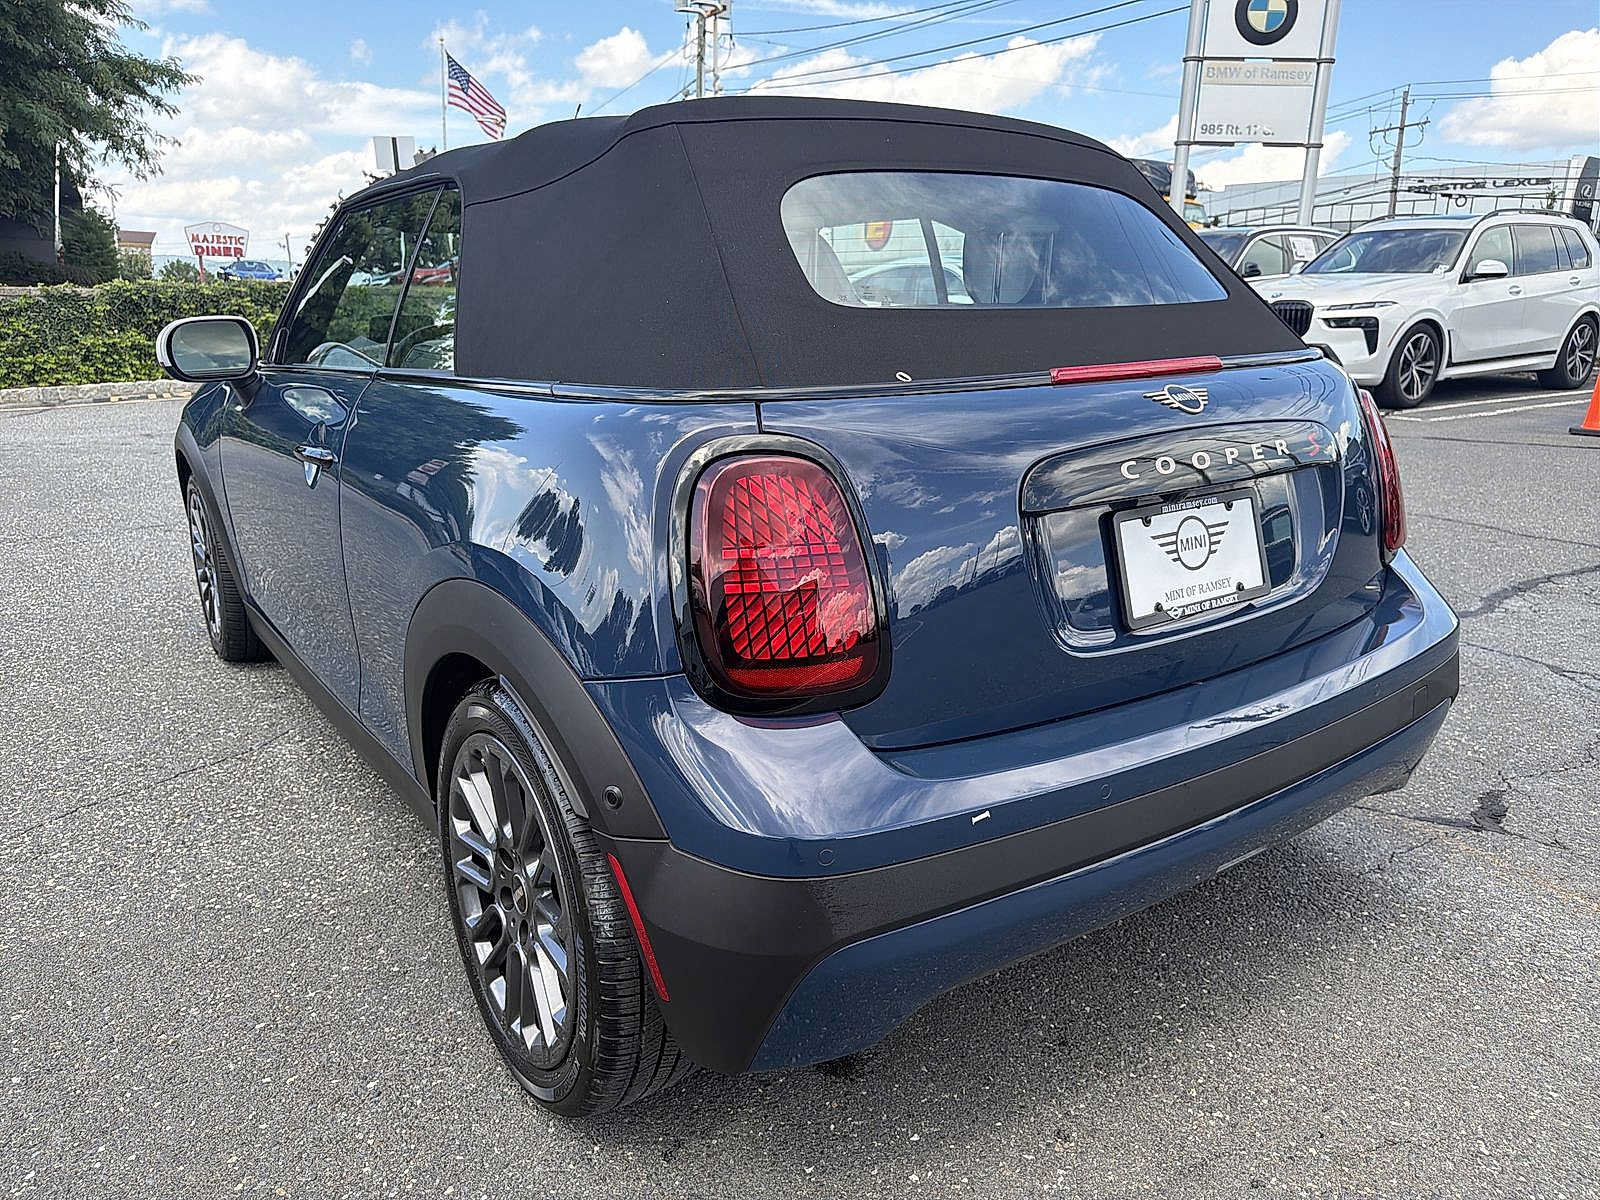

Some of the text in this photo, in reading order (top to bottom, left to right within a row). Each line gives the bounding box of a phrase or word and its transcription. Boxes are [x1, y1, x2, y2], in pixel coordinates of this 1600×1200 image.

[1206, 66, 1312, 81] BMW of Ramsey
[1200, 123, 1223, 135] 985
[1225, 124, 1242, 136] Rt.
[1492, 178, 1551, 188] LEXUS
[191, 233, 245, 245] MAJESTIC
[194, 245, 244, 257] DINER
[1172, 392, 1198, 401] MINI
[1120, 432, 1320, 479] COOPER S
[1161, 496, 1218, 513] miniramsey.com
[1179, 534, 1207, 552] MINI
[1164, 577, 1232, 602] MINI OF RAMSEY
[1184, 604, 1202, 615] MINI
[1201, 600, 1211, 611] OF
